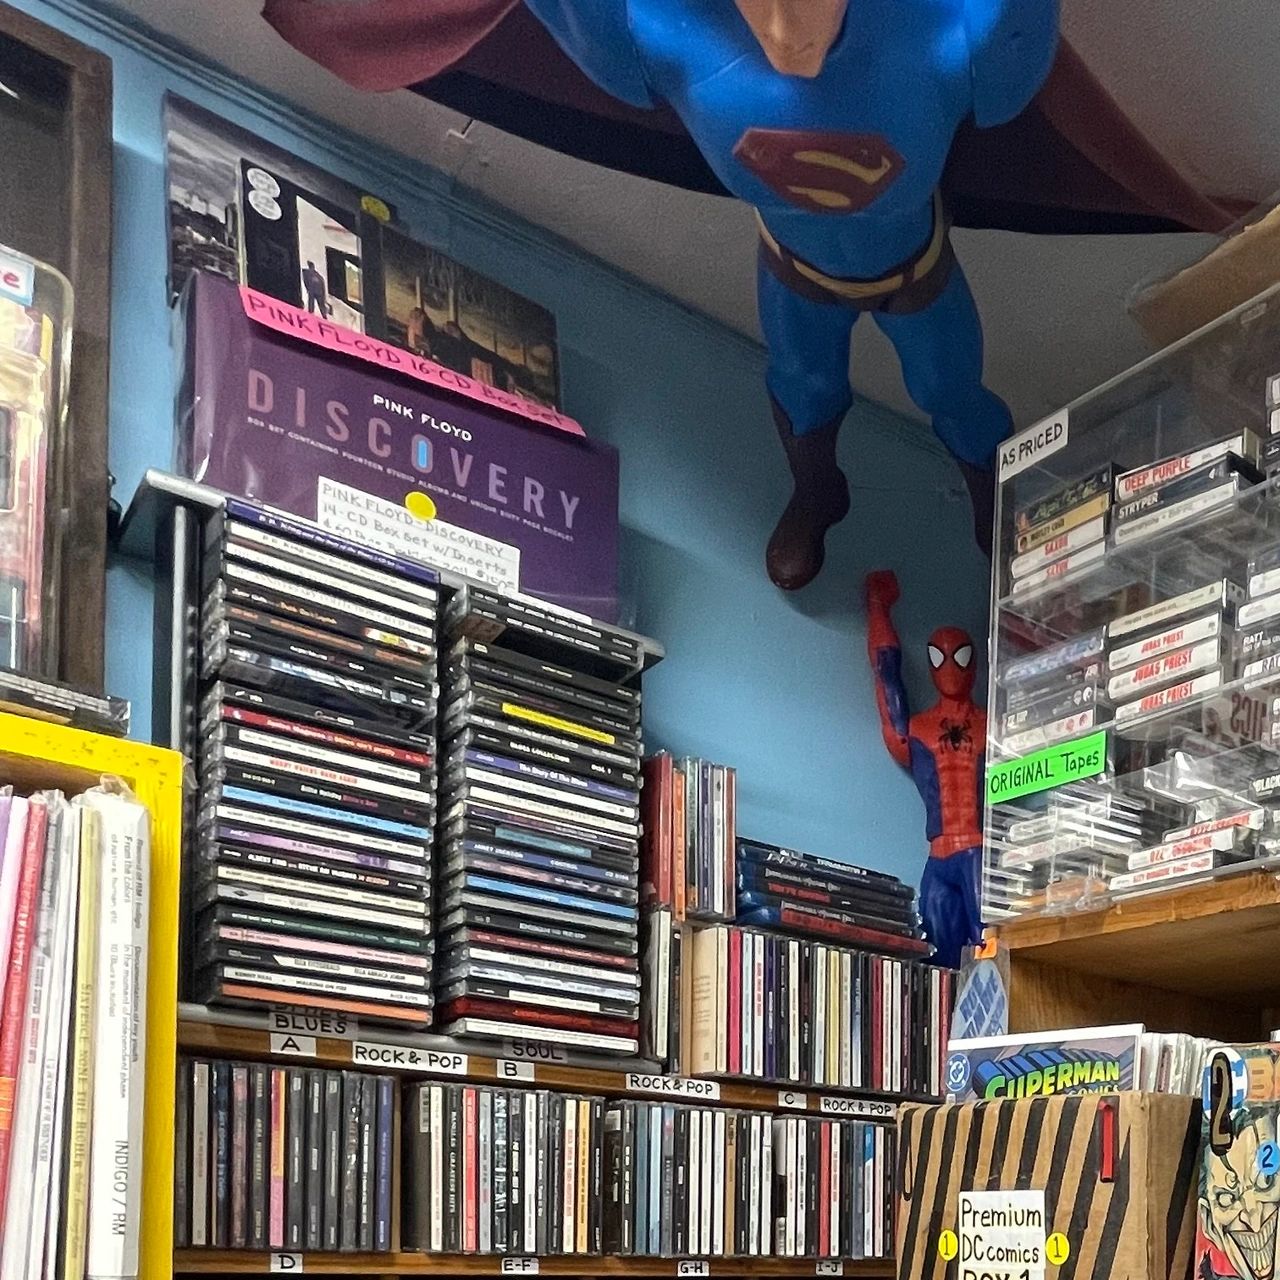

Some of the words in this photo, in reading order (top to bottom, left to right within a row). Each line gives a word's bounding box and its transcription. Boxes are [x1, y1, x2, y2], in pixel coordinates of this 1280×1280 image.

[249, 294, 314, 334] PINK
[318, 322, 401, 363] FLOYD
[372, 394, 414, 420] PINK
[420, 412, 473, 442] FLOYD
[247, 368, 581, 530] DISCOVERY
[1000, 447, 1019, 469] AS
[1018, 422, 1064, 460] PRICED
[322, 483, 362, 511] PINK
[1243, 631, 1264, 646] RATT
[990, 758, 1055, 794] ORIGINAL
[1059, 751, 1101, 777] Tapes
[275, 1014, 348, 1035] BLUES
[280, 1036, 301, 1052] A
[354, 1044, 403, 1063] ROCK
[407, 1050, 422, 1063] &
[428, 1053, 463, 1069] POP
[511, 1040, 564, 1061] SOUL
[503, 1061, 519, 1076] B
[984, 1061, 1121, 1099] SUPERMAN
[630, 1074, 671, 1092] ROCK
[673, 1078, 684, 1093] &
[686, 1080, 714, 1096] POP
[784, 1093, 796, 1105] C
[823, 1099, 855, 1112] ROCK
[869, 1102, 893, 1116] POP
[1210, 1051, 1233, 1155] 2
[114, 1139, 130, 1194] INDIGO
[111, 1211, 127, 1237] RM
[961, 1203, 1043, 1230] Premium
[279, 1254, 296, 1270] D
[961, 1237, 984, 1263] DC
[984, 1242, 1041, 1265] comics
[503, 1258, 532, 1273] E-F
[679, 1260, 705, 1275] G-H
